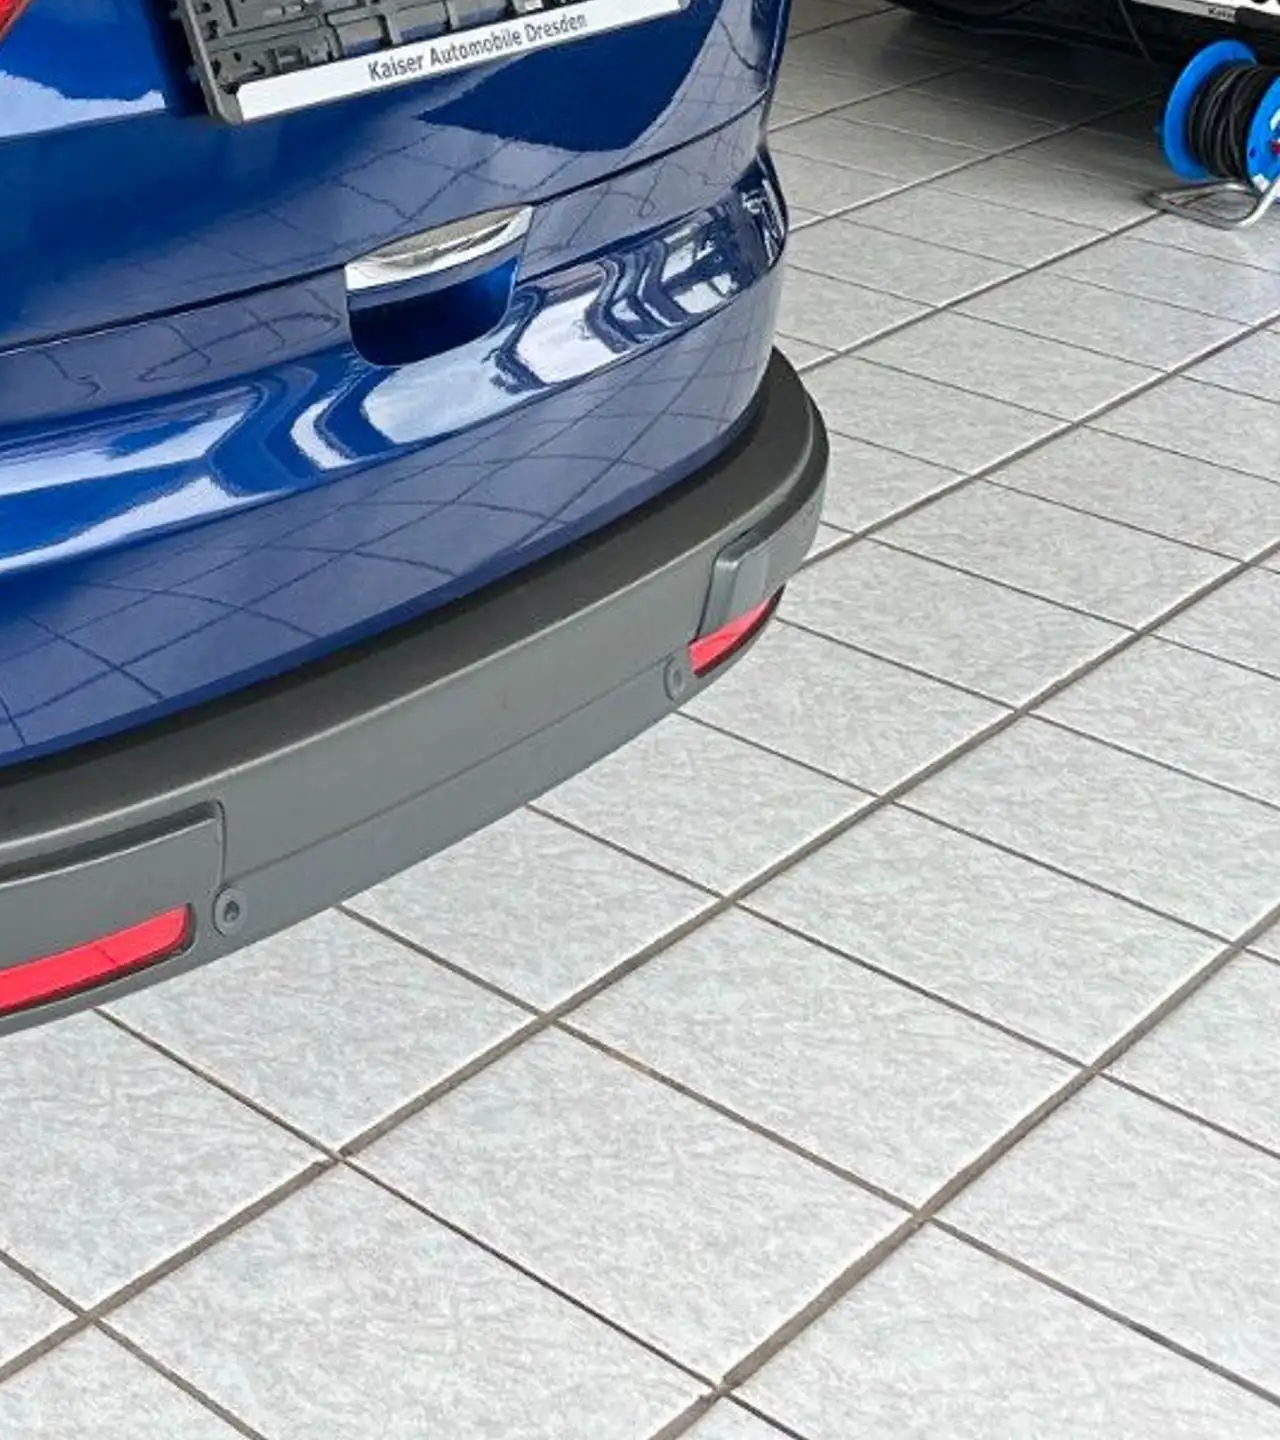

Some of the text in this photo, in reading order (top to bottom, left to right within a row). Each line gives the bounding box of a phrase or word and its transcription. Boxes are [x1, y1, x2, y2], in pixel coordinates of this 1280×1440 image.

[368, 13, 588, 81] Kaiser Automobile Dresden
